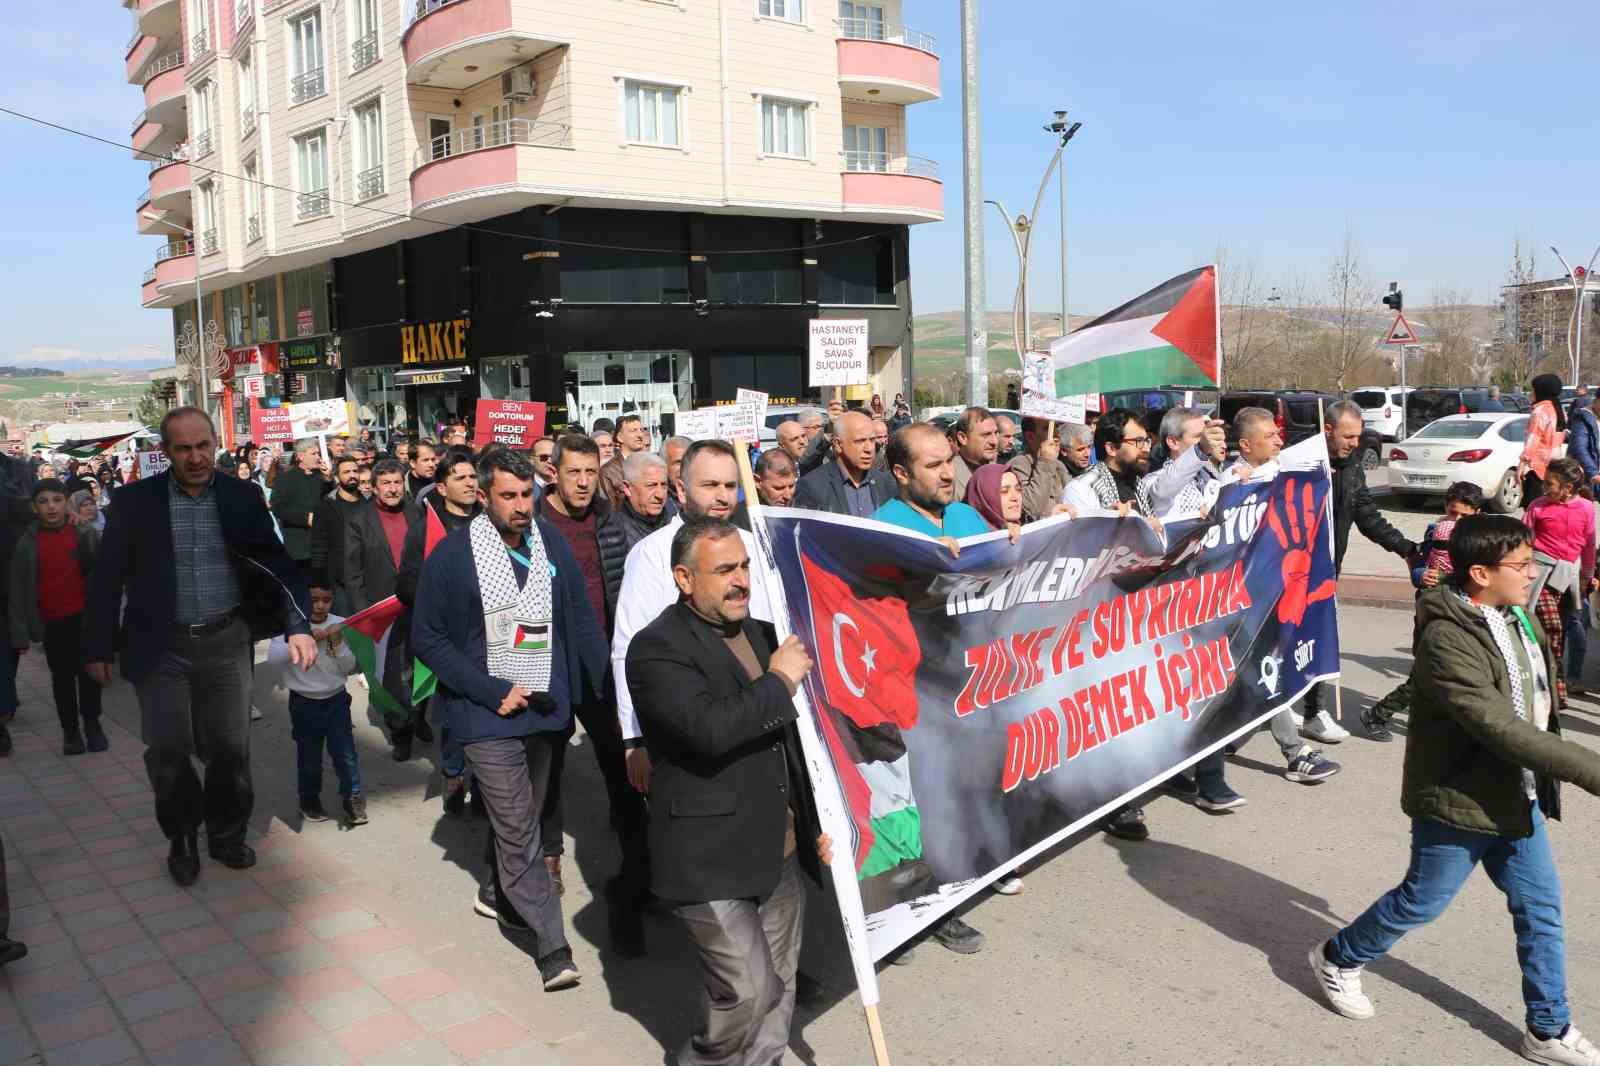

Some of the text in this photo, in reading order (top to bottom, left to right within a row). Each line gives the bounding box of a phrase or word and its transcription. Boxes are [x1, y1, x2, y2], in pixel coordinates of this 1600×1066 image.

[811, 325, 866, 335] HASTANEYE
[820, 337, 857, 346] SALDIRI
[824, 349, 854, 359] SAVAŞ
[816, 360, 862, 371] SUÇUDUR
[501, 402, 523, 412] BEN
[488, 411, 535, 421] DOKTORUM
[493, 424, 528, 434] HEDEF
[494, 433, 525, 445] DEĞİL
[1089, 559, 1253, 661] SOYKIRIMA
[1002, 632, 1237, 792] DUR DEMEK İÇİN!
